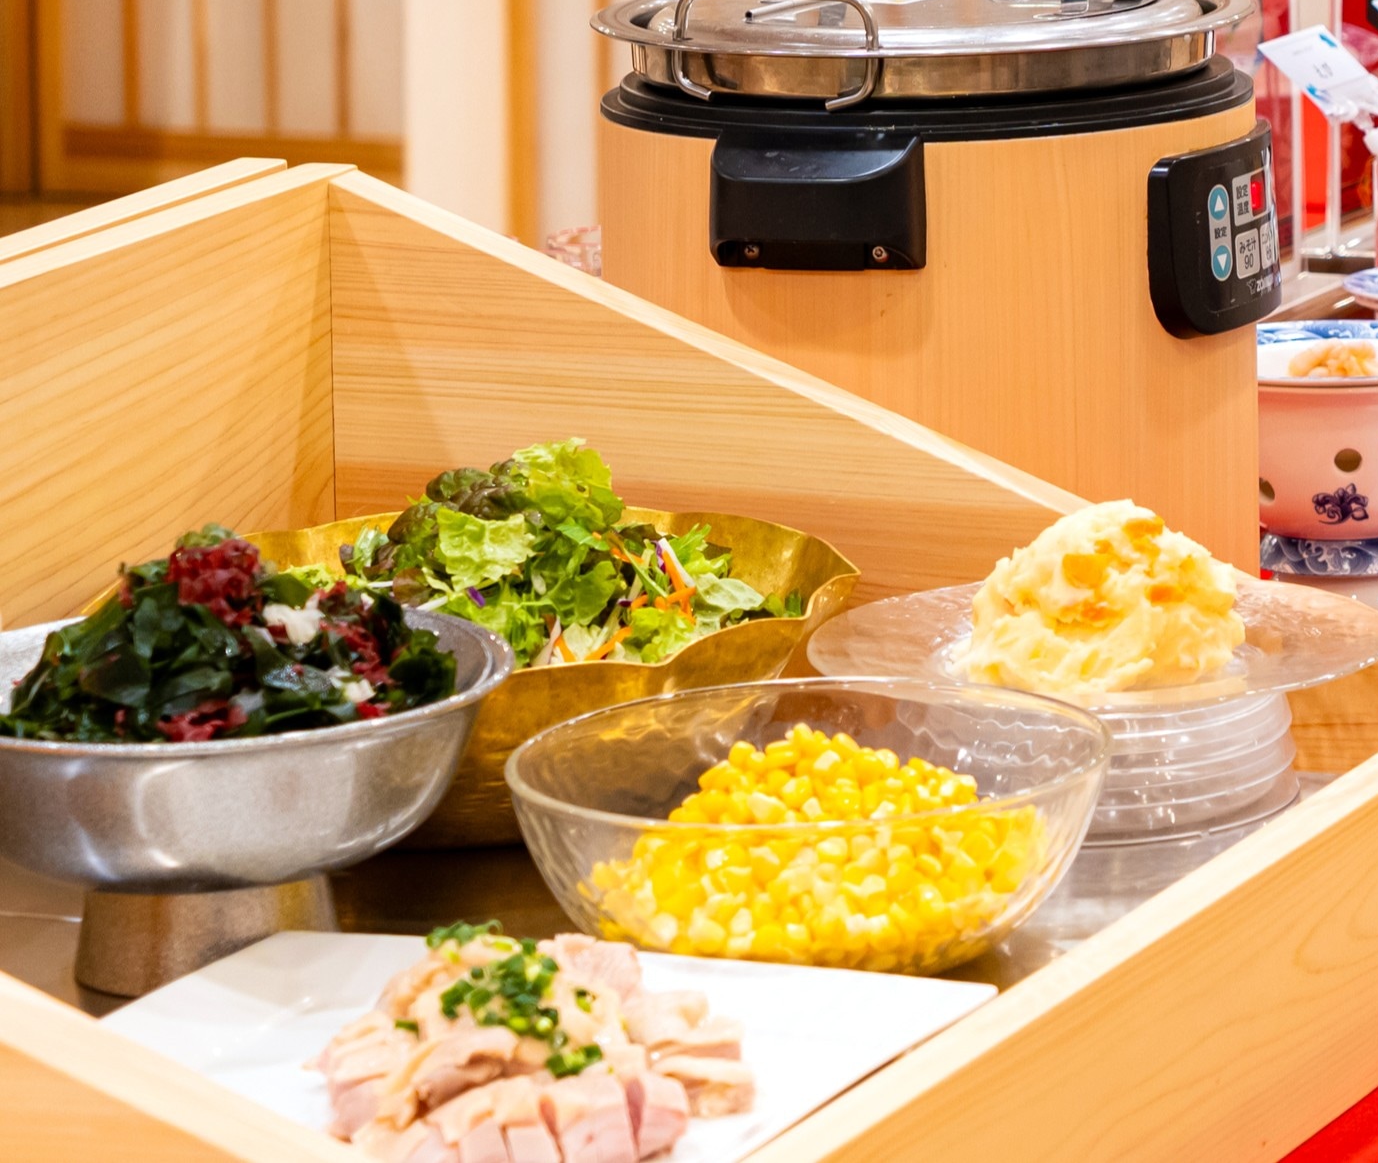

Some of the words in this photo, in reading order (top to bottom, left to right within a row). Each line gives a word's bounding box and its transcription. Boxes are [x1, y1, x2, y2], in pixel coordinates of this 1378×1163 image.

[1235, 184, 1248, 199] 設定
[1237, 200, 1249, 215] 温度
[1214, 226, 1228, 240] 設定
[1239, 236, 1256, 254] みそ汁
[1244, 253, 1255, 269] 90
